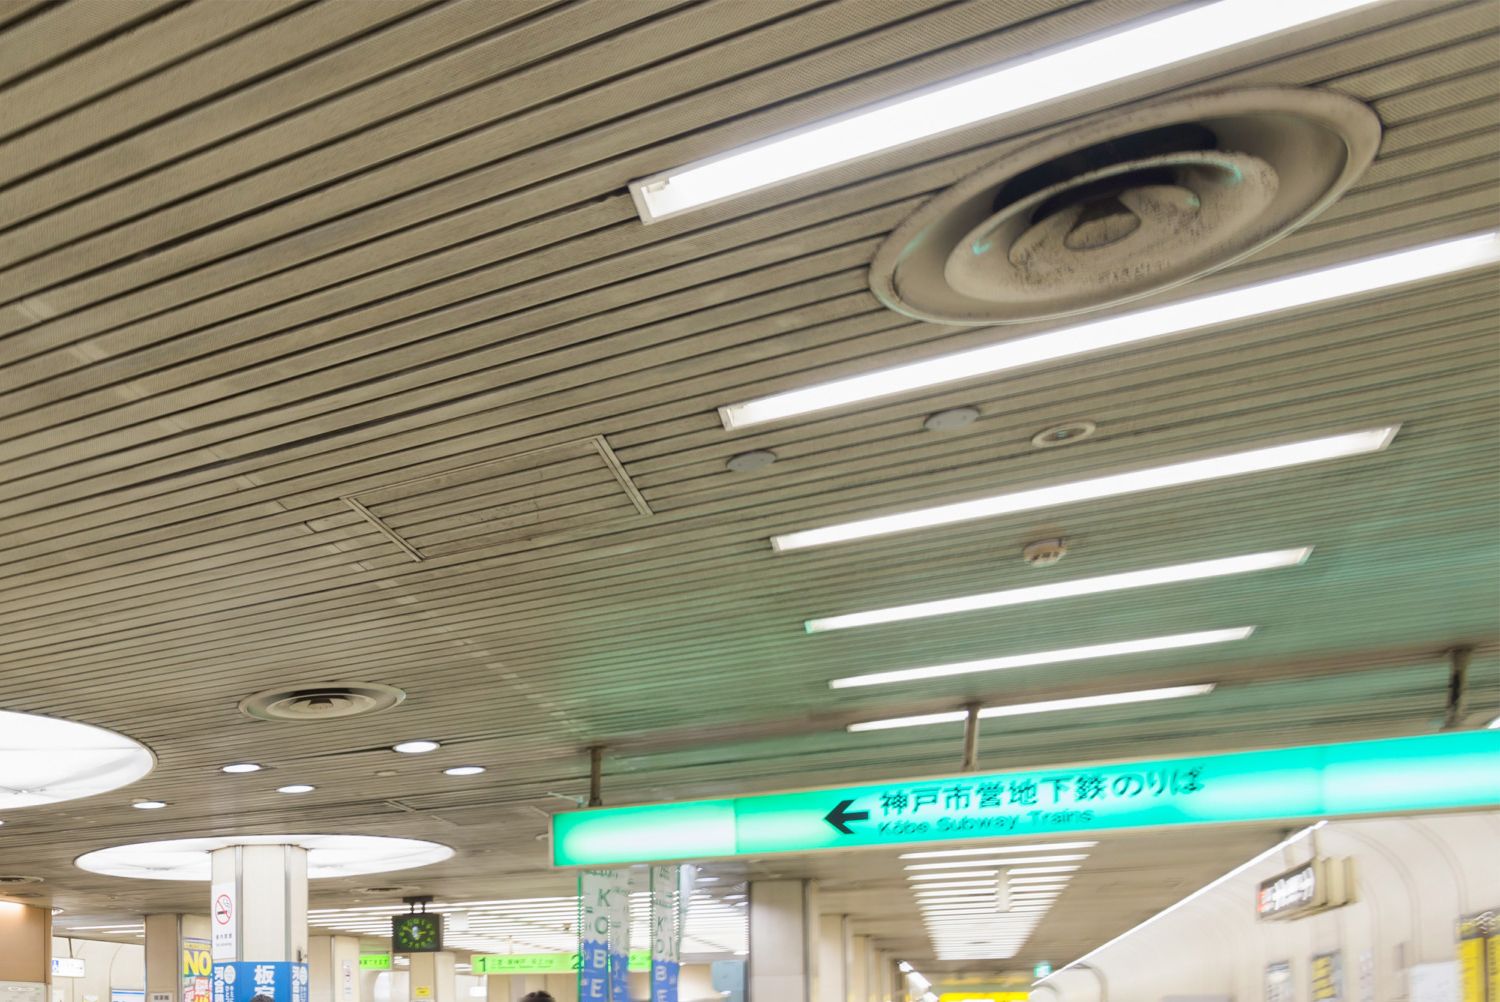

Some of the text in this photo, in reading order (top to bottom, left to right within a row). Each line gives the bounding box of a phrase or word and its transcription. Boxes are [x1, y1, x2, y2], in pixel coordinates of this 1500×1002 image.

[879, 765, 1205, 817] 神戸市営地下鉄のりば
[937, 814, 1016, 832] Subway
[1027, 808, 1094, 825] Trains
[478, 957, 486, 972] 1
